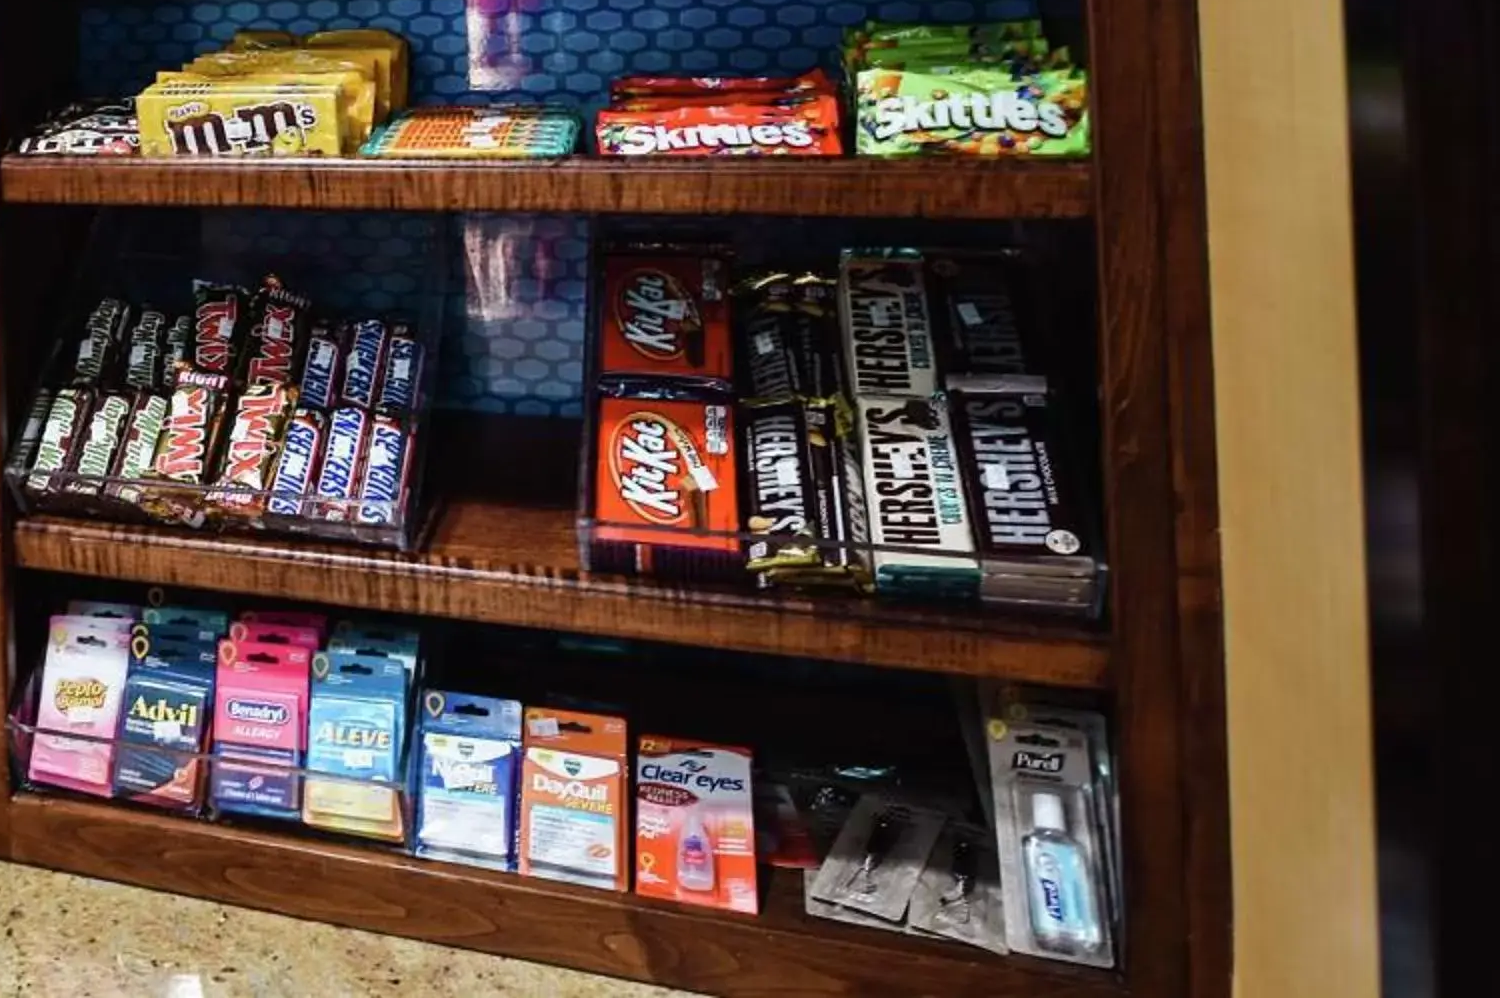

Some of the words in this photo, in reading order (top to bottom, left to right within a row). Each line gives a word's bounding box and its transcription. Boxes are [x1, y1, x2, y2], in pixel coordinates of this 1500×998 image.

[876, 90, 1068, 140] Skittles
[625, 276, 676, 352] KitKat
[621, 419, 678, 516] KitKat
[129, 695, 197, 727] Advil
[231, 701, 286, 723] Benadryl
[233, 724, 282, 740] ALLERGY
[315, 720, 391, 750] ALEVE
[532, 773, 609, 802] DayQuil
[641, 764, 692, 785] Clear
[695, 775, 745, 794] eyes
